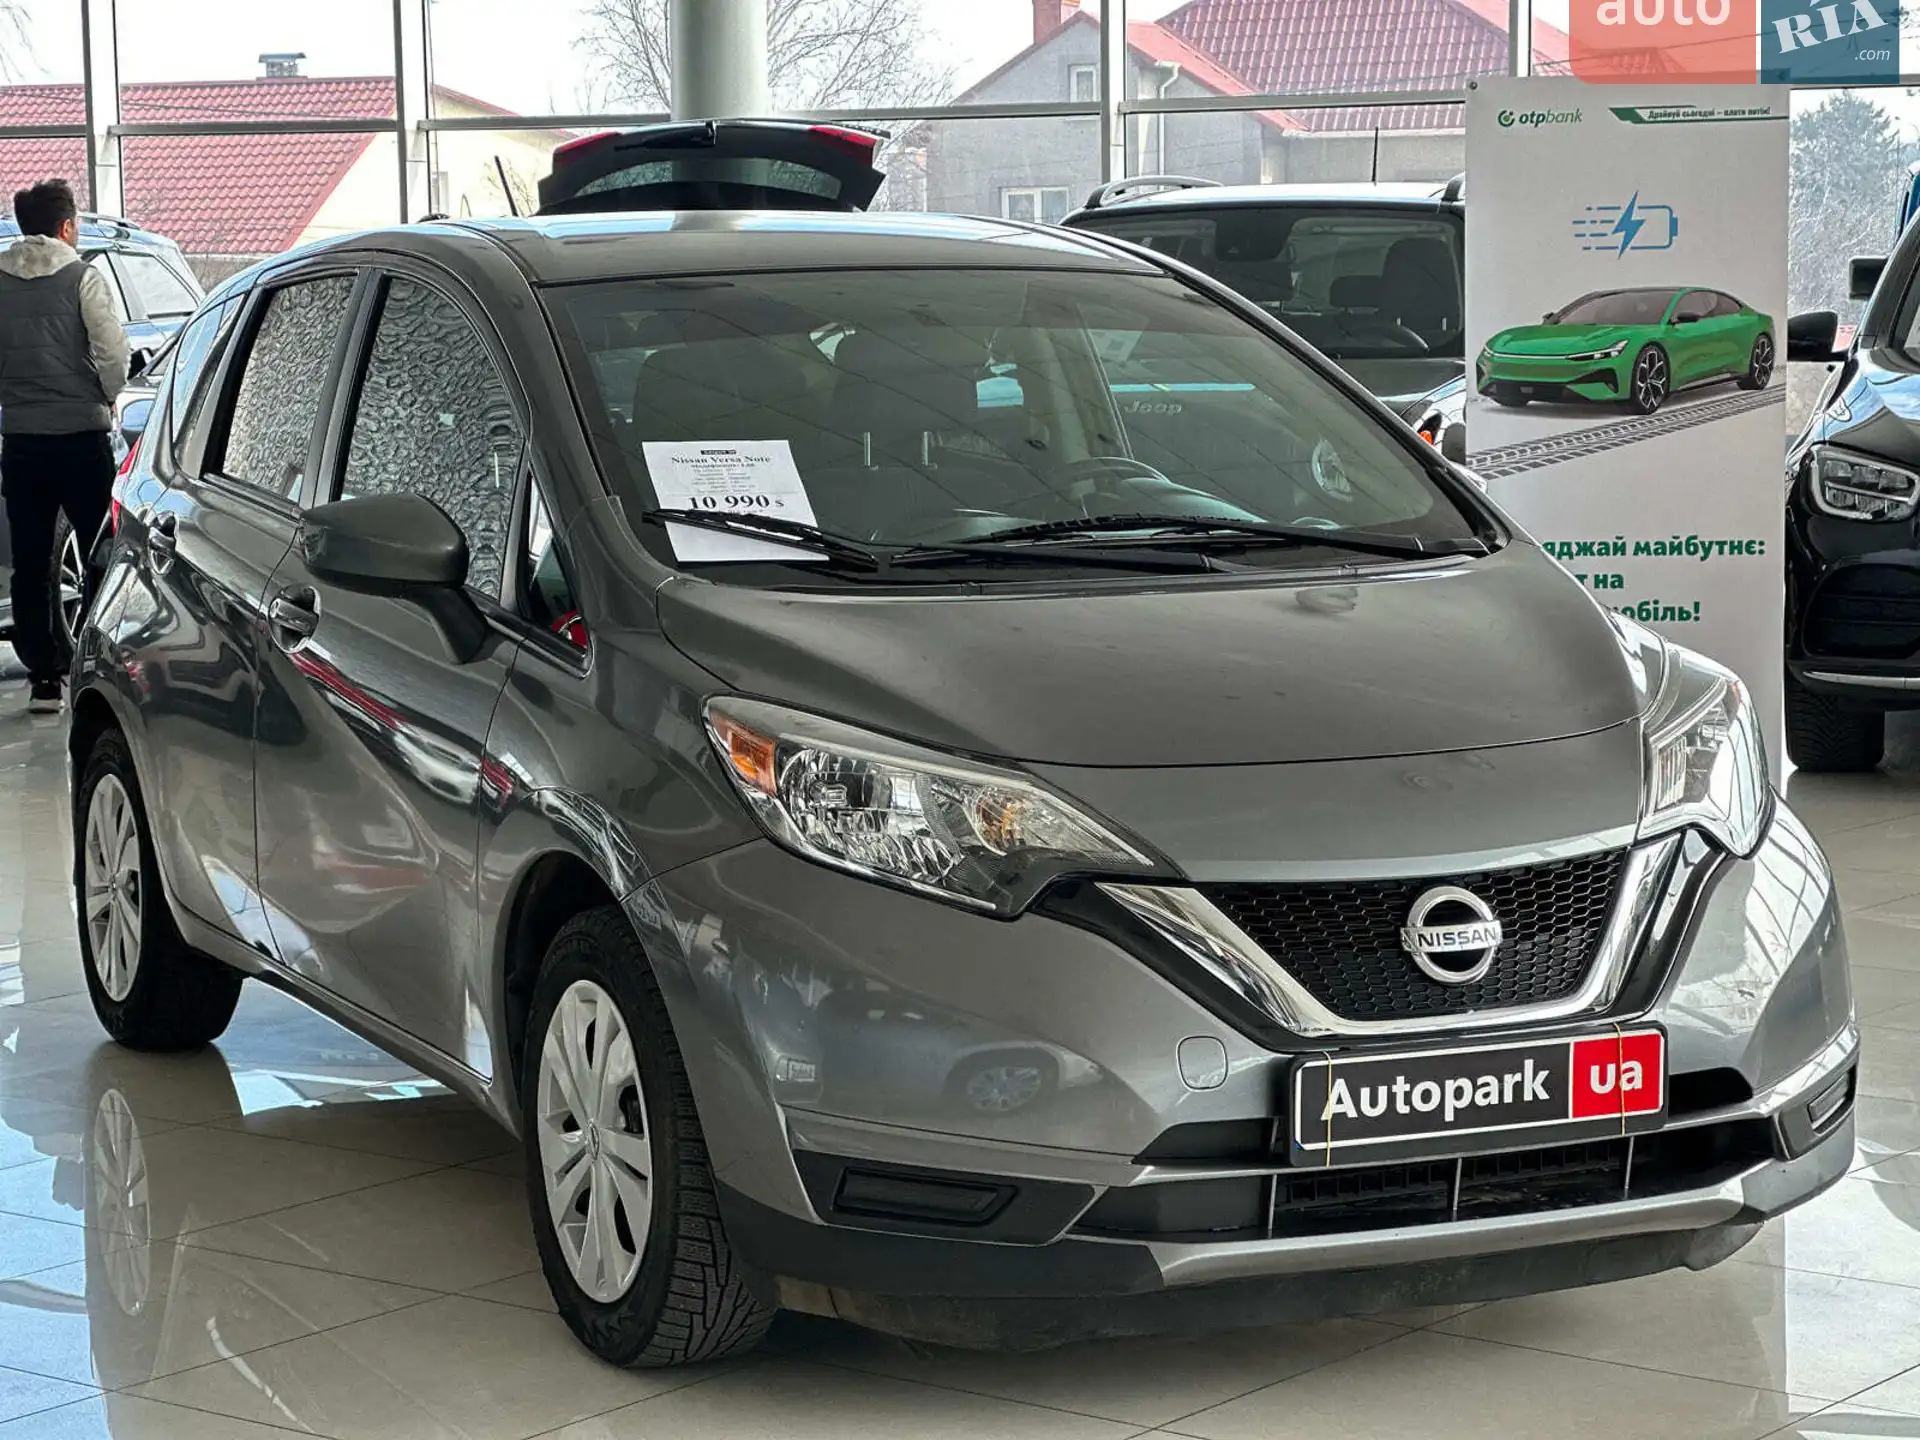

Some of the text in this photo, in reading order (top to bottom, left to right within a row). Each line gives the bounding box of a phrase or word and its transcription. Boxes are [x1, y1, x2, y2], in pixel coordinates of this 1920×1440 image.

[1519, 108, 1583, 128] otpbank
[672, 456, 708, 464] Nissan
[744, 455, 771, 463] Note
[689, 496, 717, 509] 10
[725, 495, 770, 508] 990
[1543, 535, 1766, 562] яджай майбутнє:
[1594, 574, 1625, 589] на
[1417, 926, 1497, 948] NISSAN
[1320, 1058, 1643, 1122] Autopark ua
